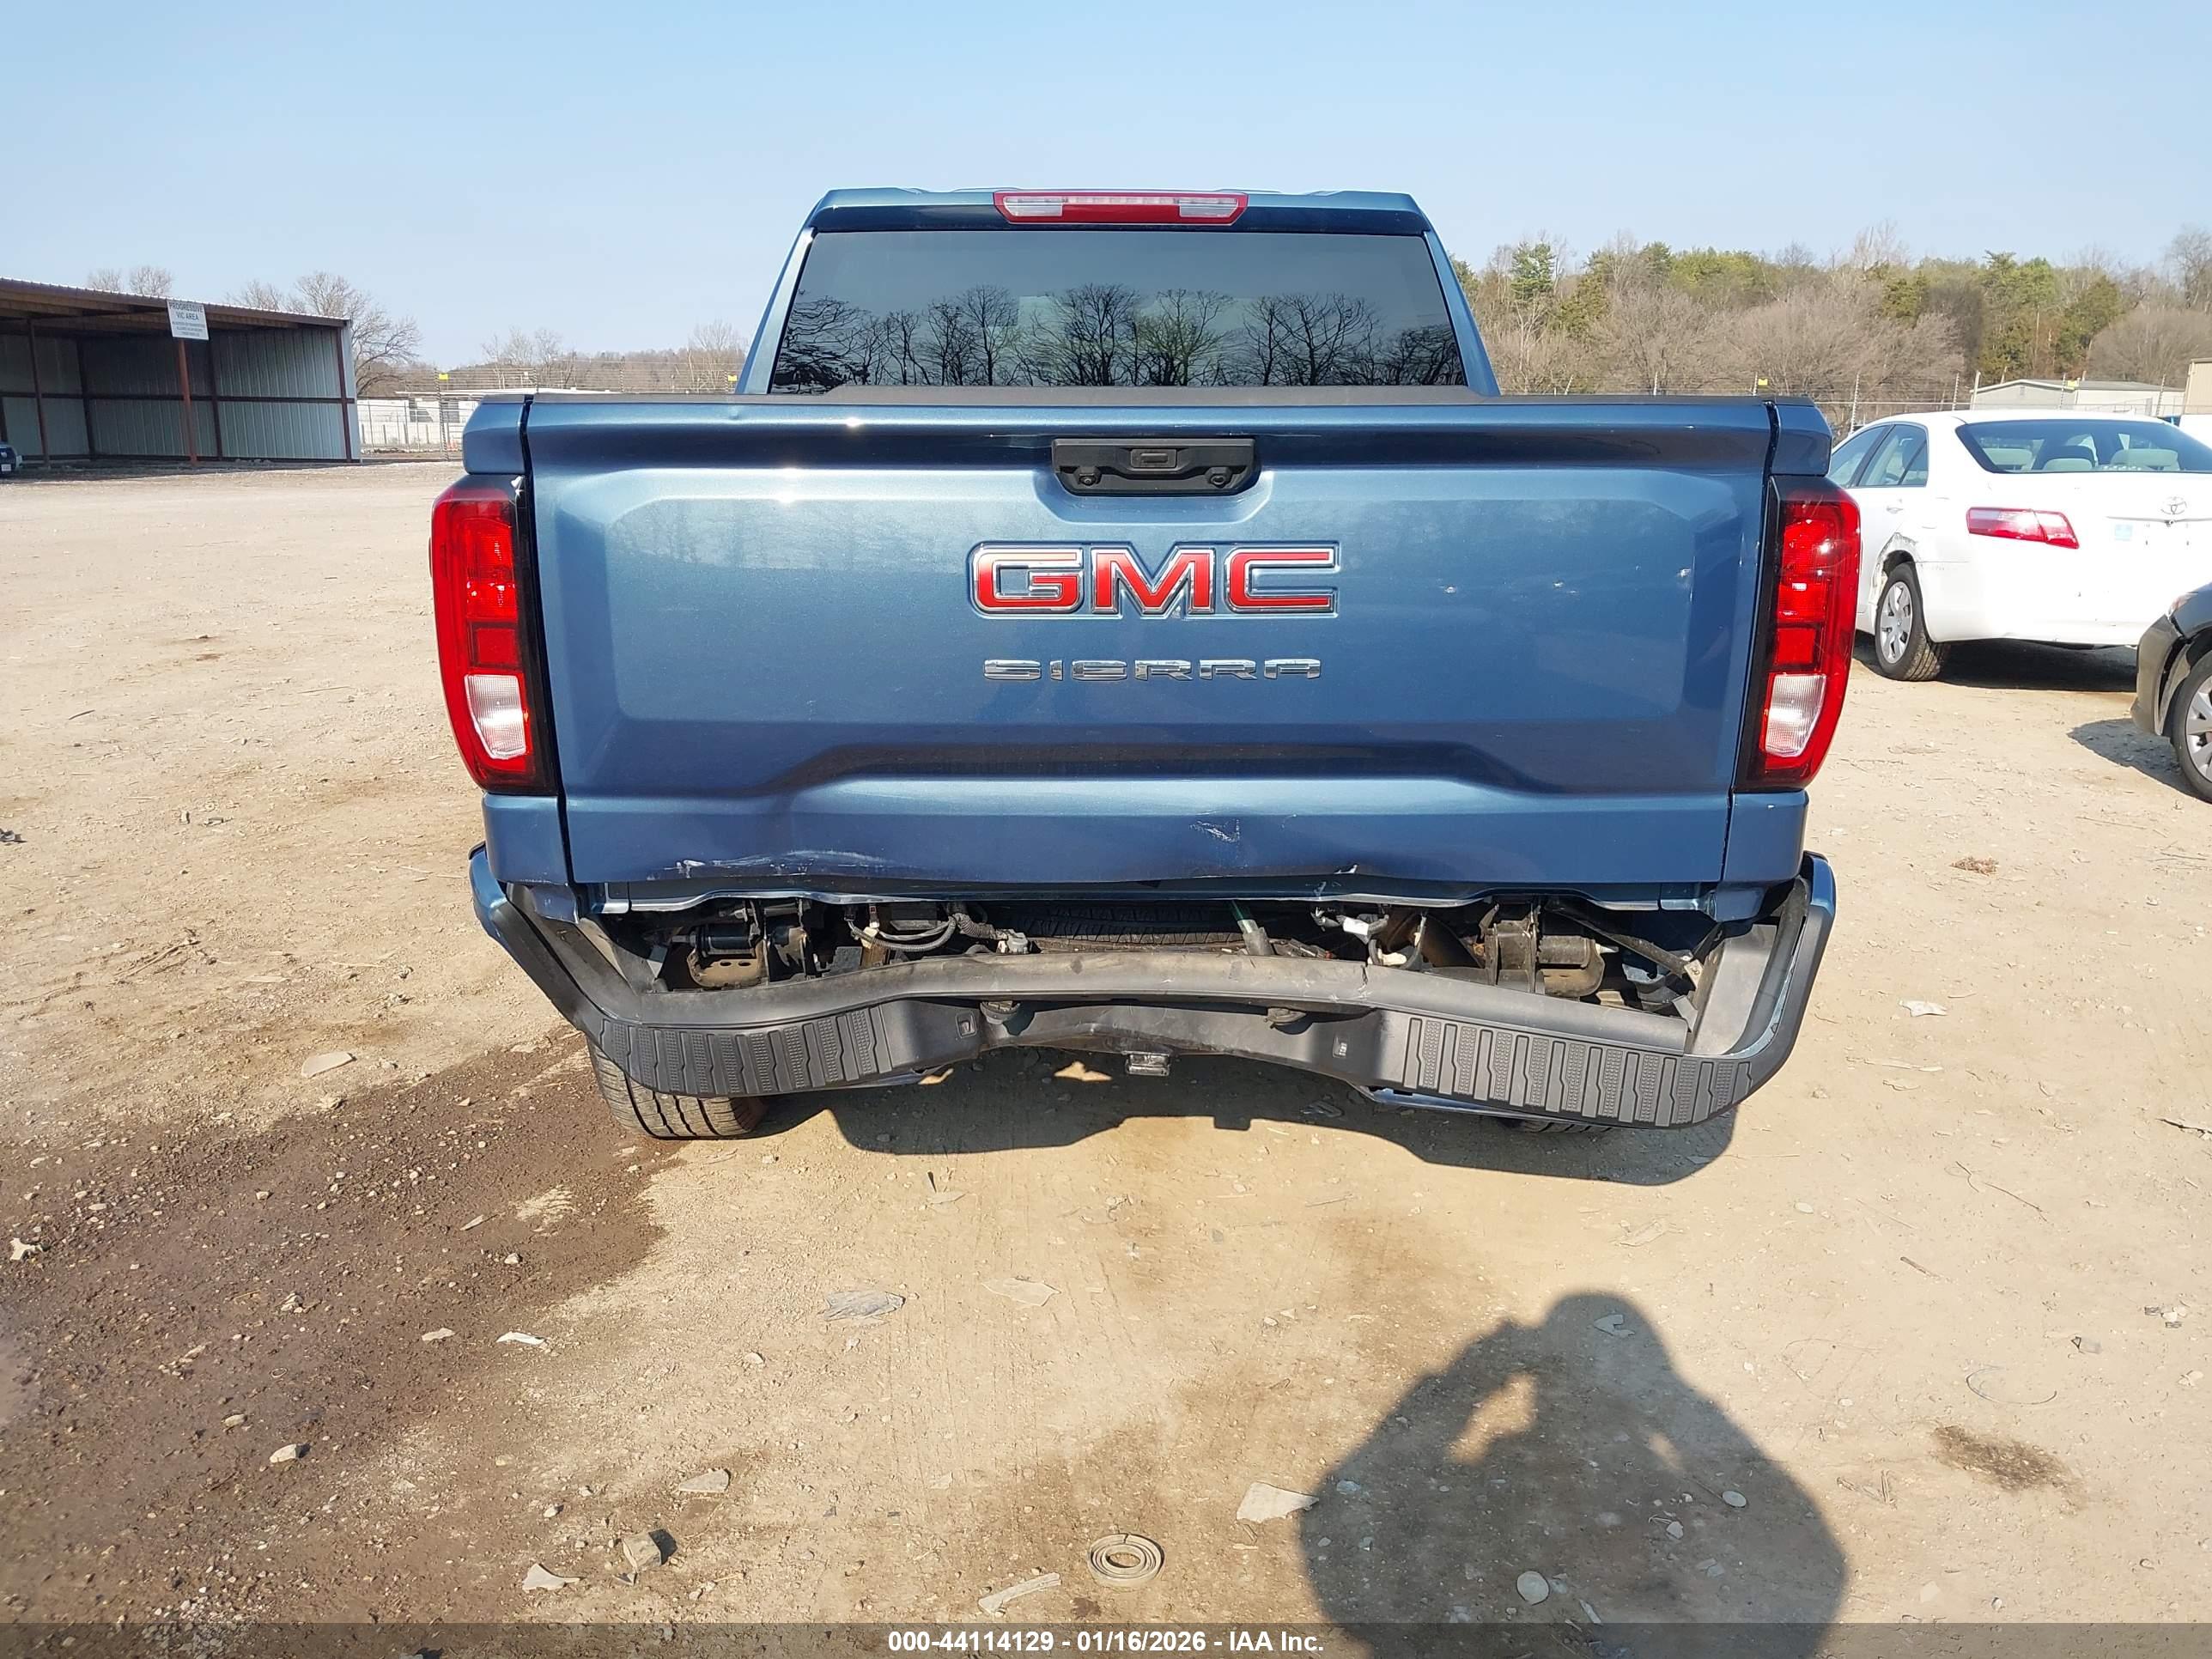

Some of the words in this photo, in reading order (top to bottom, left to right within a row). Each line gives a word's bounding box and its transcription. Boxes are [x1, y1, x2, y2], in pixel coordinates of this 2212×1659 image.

[168, 301, 204, 313] PROGRESSIVE
[185, 313, 199, 321] AREA
[969, 542, 1340, 619] GMC
[983, 659, 1322, 681] SIERRA
